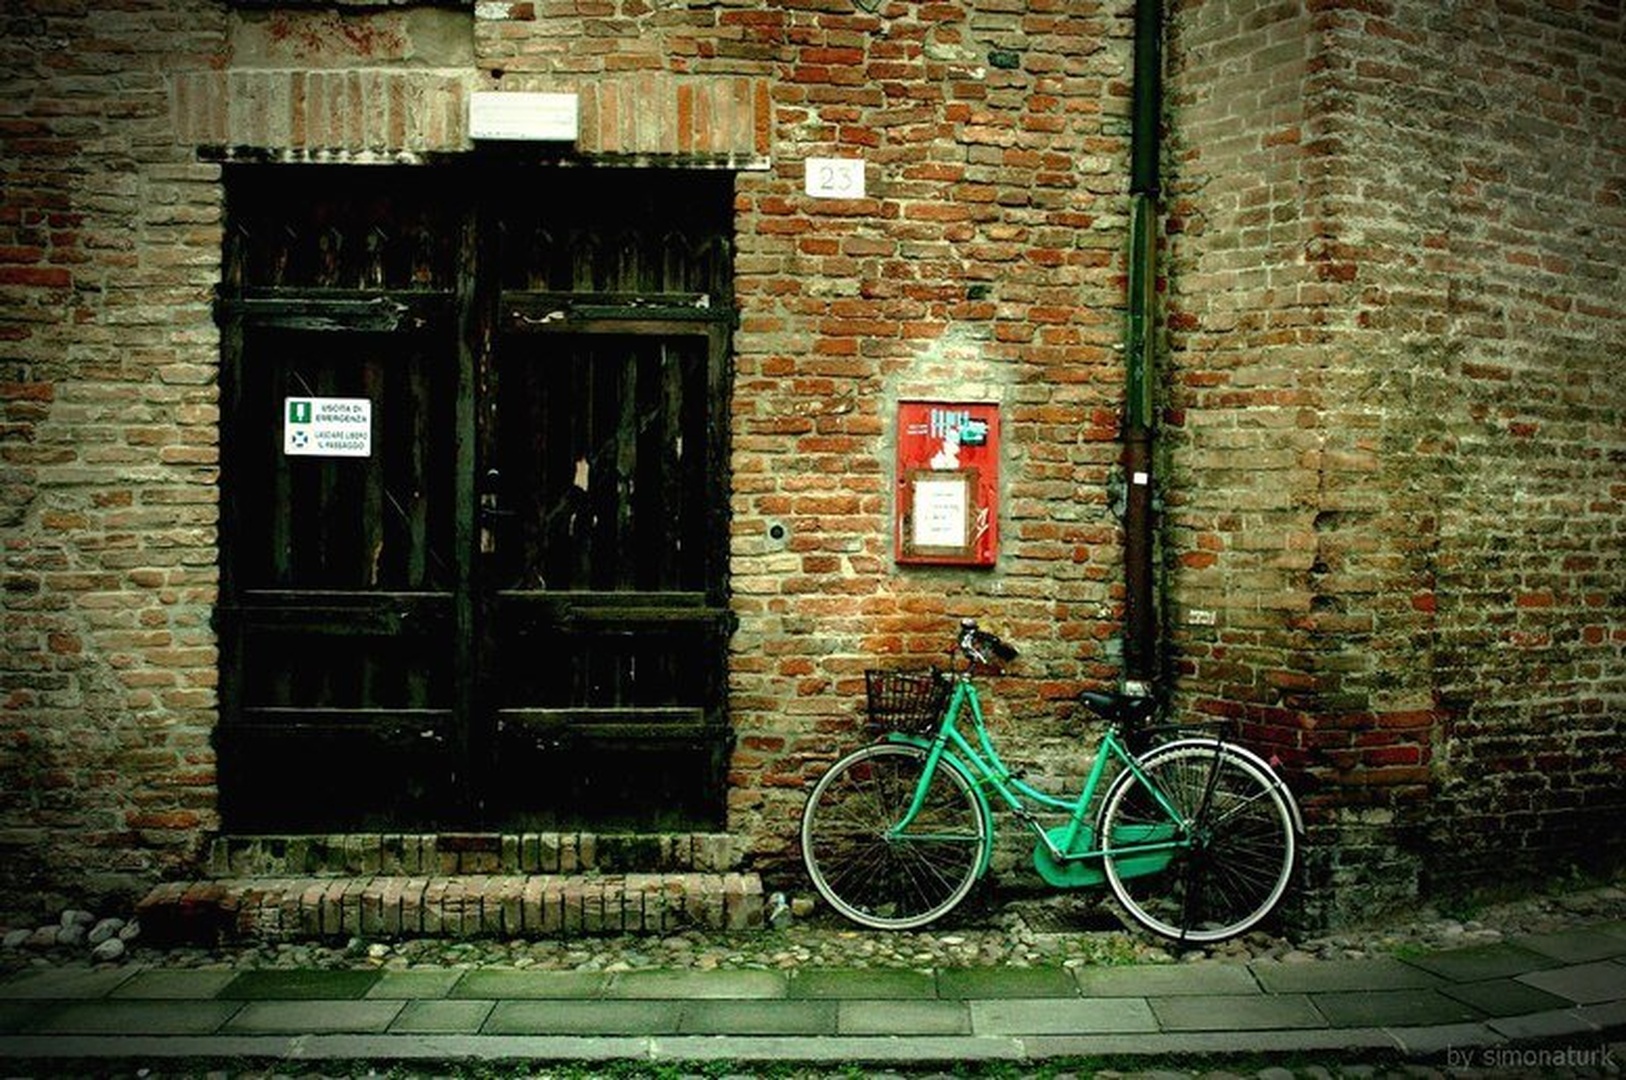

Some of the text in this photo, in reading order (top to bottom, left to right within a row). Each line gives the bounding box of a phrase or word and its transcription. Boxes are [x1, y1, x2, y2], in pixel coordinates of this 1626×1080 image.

[820, 166, 853, 191] 23
[321, 404, 351, 414] USCITA
[315, 414, 367, 423] EMERGENZA
